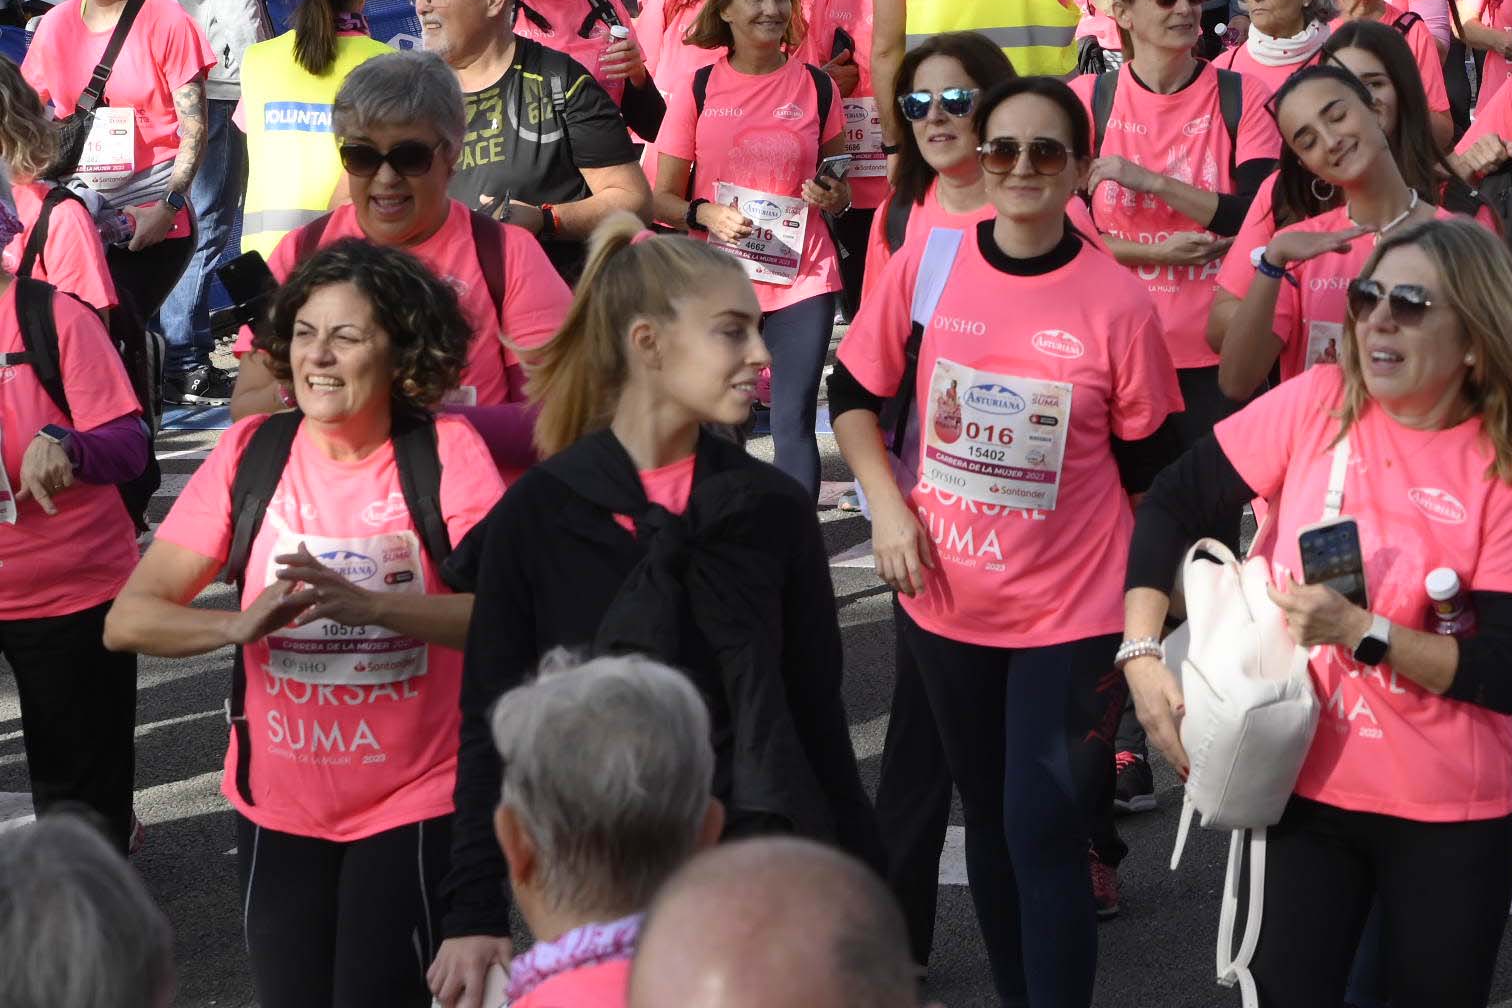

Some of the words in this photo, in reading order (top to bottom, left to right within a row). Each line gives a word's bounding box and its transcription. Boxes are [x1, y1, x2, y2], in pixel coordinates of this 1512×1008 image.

[703, 106, 745, 117] OYSHO
[745, 241, 766, 252] 4662
[1310, 278, 1350, 292] OYSH
[934, 314, 986, 337] OYSHO
[1035, 336, 1083, 356] ASTURIANA
[966, 392, 1021, 411] ASTURIANA
[1032, 397, 1060, 408] SUMA
[966, 421, 1015, 446] 016
[968, 445, 1006, 462] 15402
[935, 451, 968, 469] CARRERA
[969, 463, 981, 473] DE
[981, 465, 993, 474] LA
[994, 467, 1024, 479] MUJER
[1026, 471, 1045, 481] 2023
[931, 468, 967, 489] OYSHO
[1000, 485, 1046, 499] Santander
[985, 561, 1007, 572] 2023
[327, 641, 341, 651] DE
[343, 642, 354, 651] LA
[366, 656, 418, 672] Santander
[267, 709, 382, 753] SUMA
